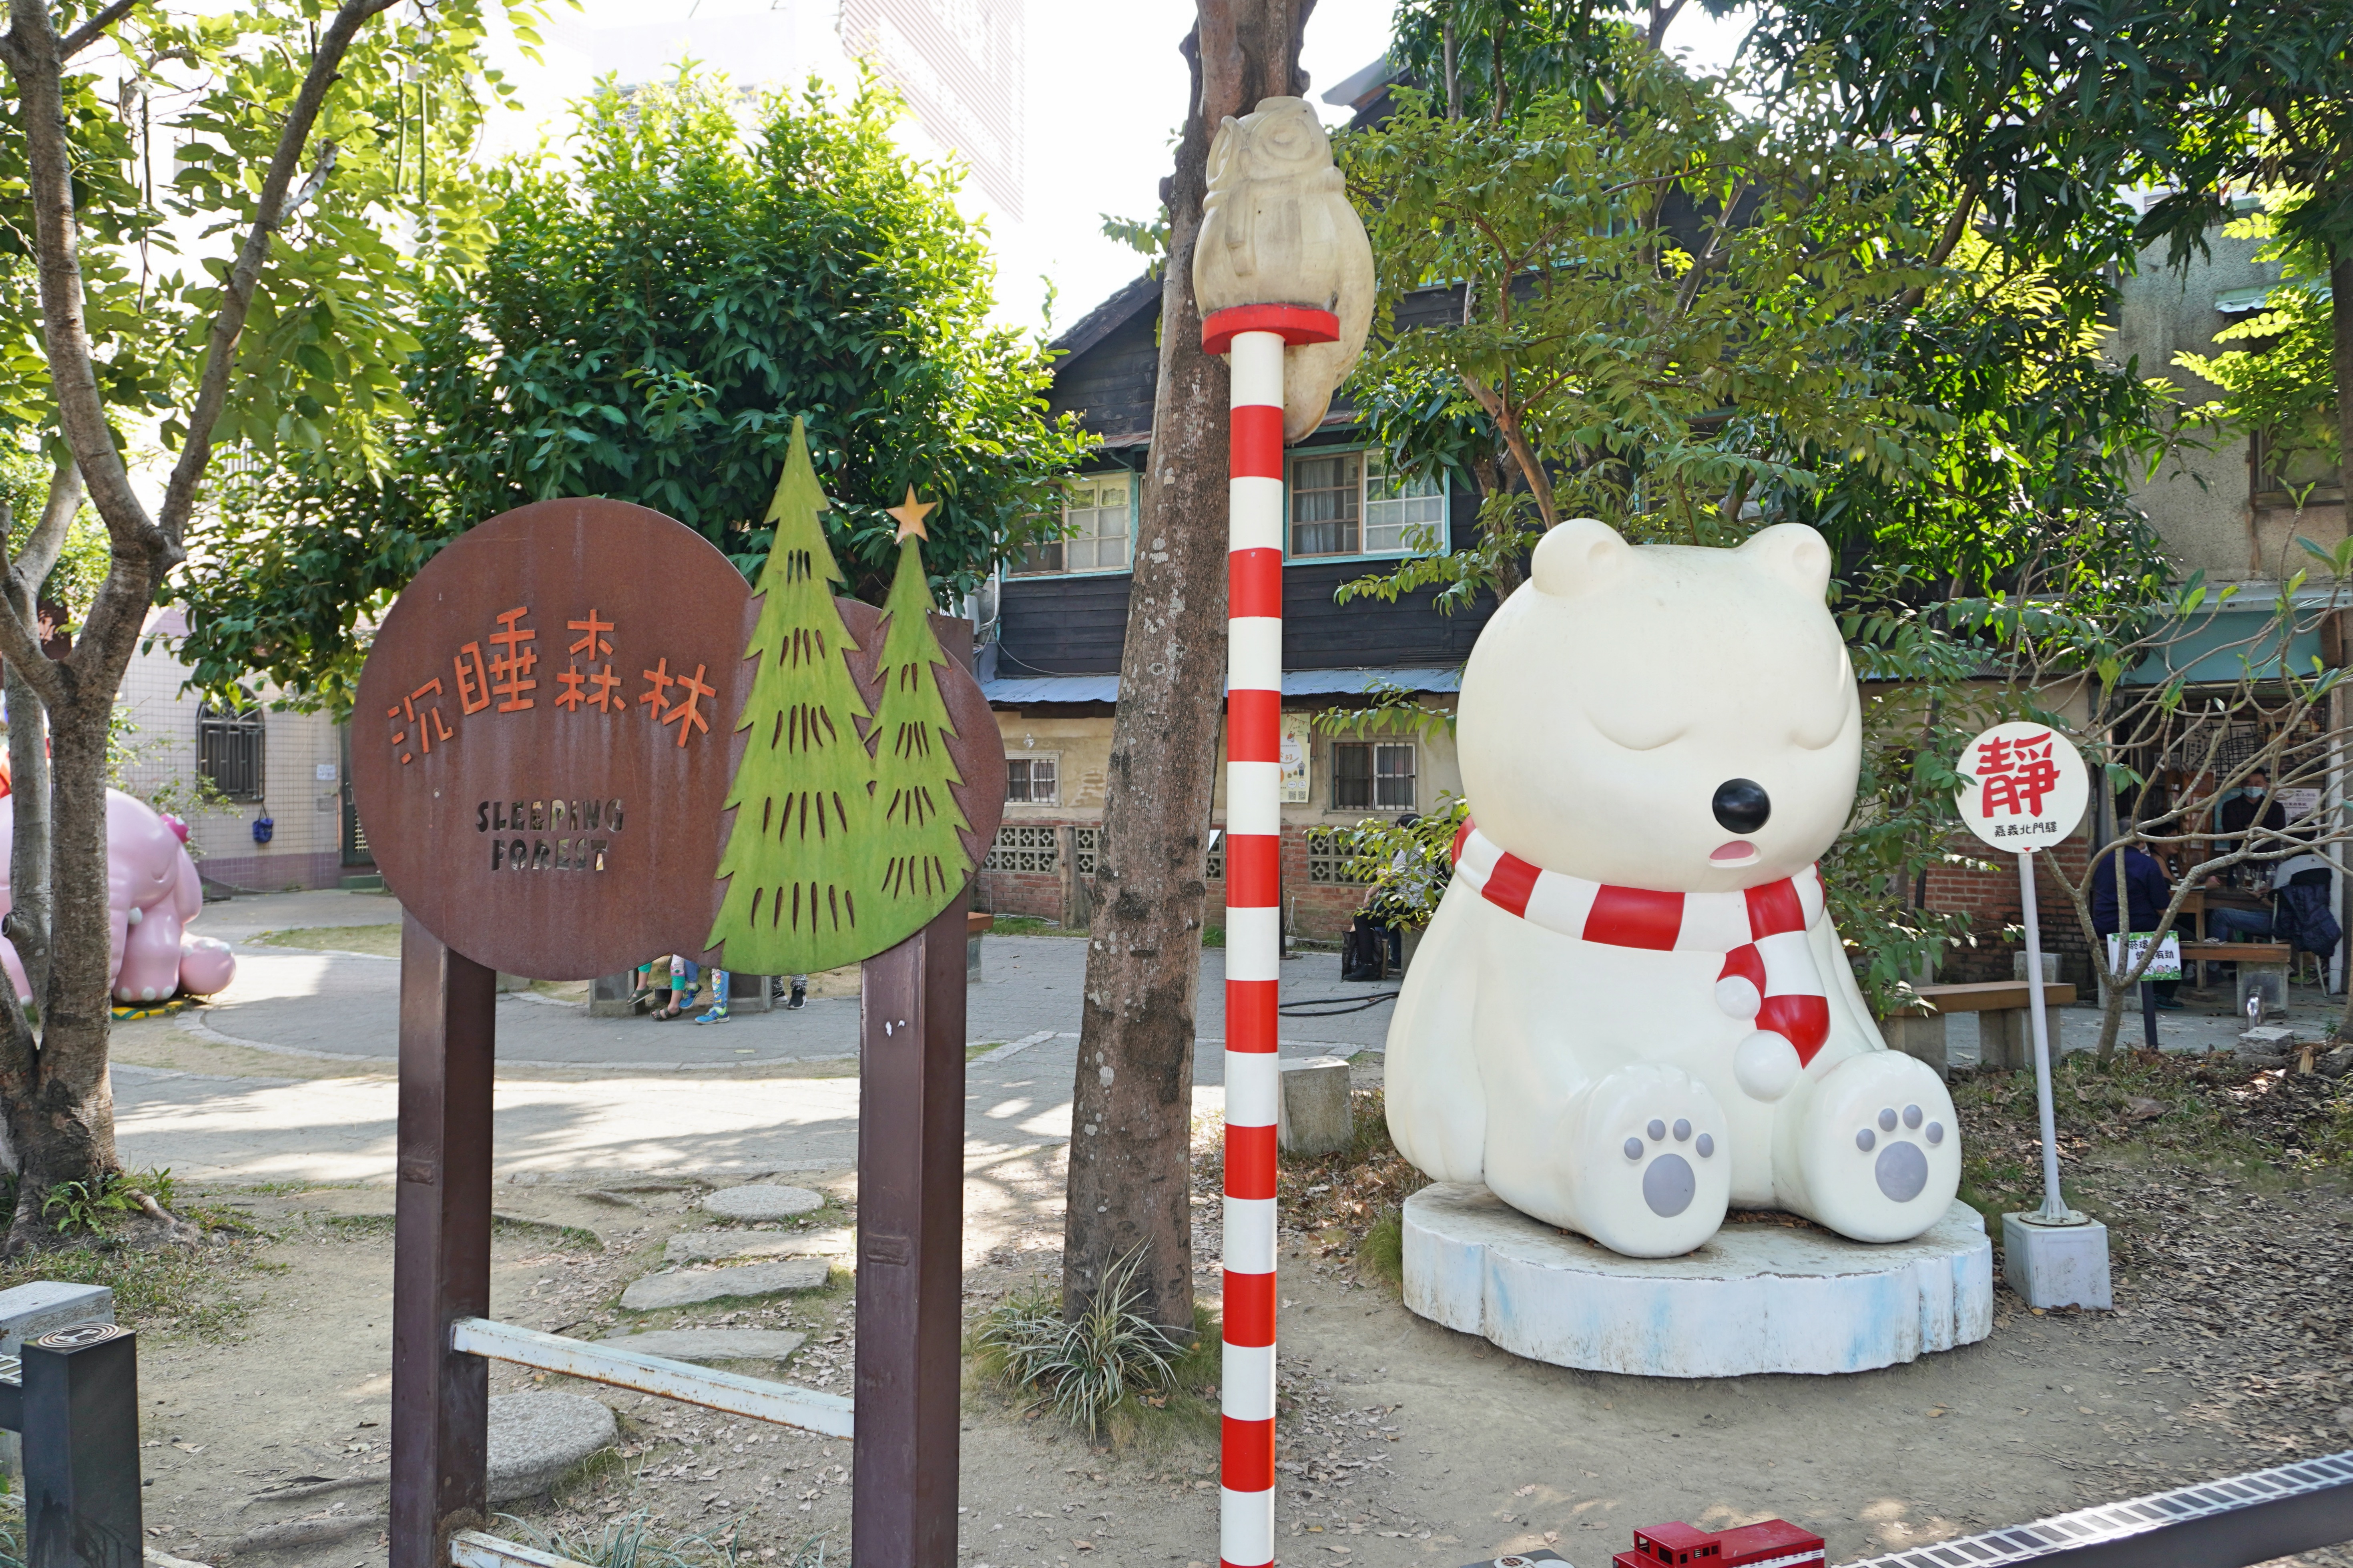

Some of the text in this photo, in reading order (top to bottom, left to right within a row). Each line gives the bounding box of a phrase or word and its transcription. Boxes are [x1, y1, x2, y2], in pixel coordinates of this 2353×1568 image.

[387, 606, 716, 764] 沉睡森林
[1976, 732, 2061, 818] 靜
[475, 798, 624, 833] SLEEPING
[1994, 821, 2057, 837] 嘉義北門驛
[491, 838, 608, 871] FOREST
[2129, 939, 2148, 949] 菸環
[2136, 950, 2174, 960] 健有勁
